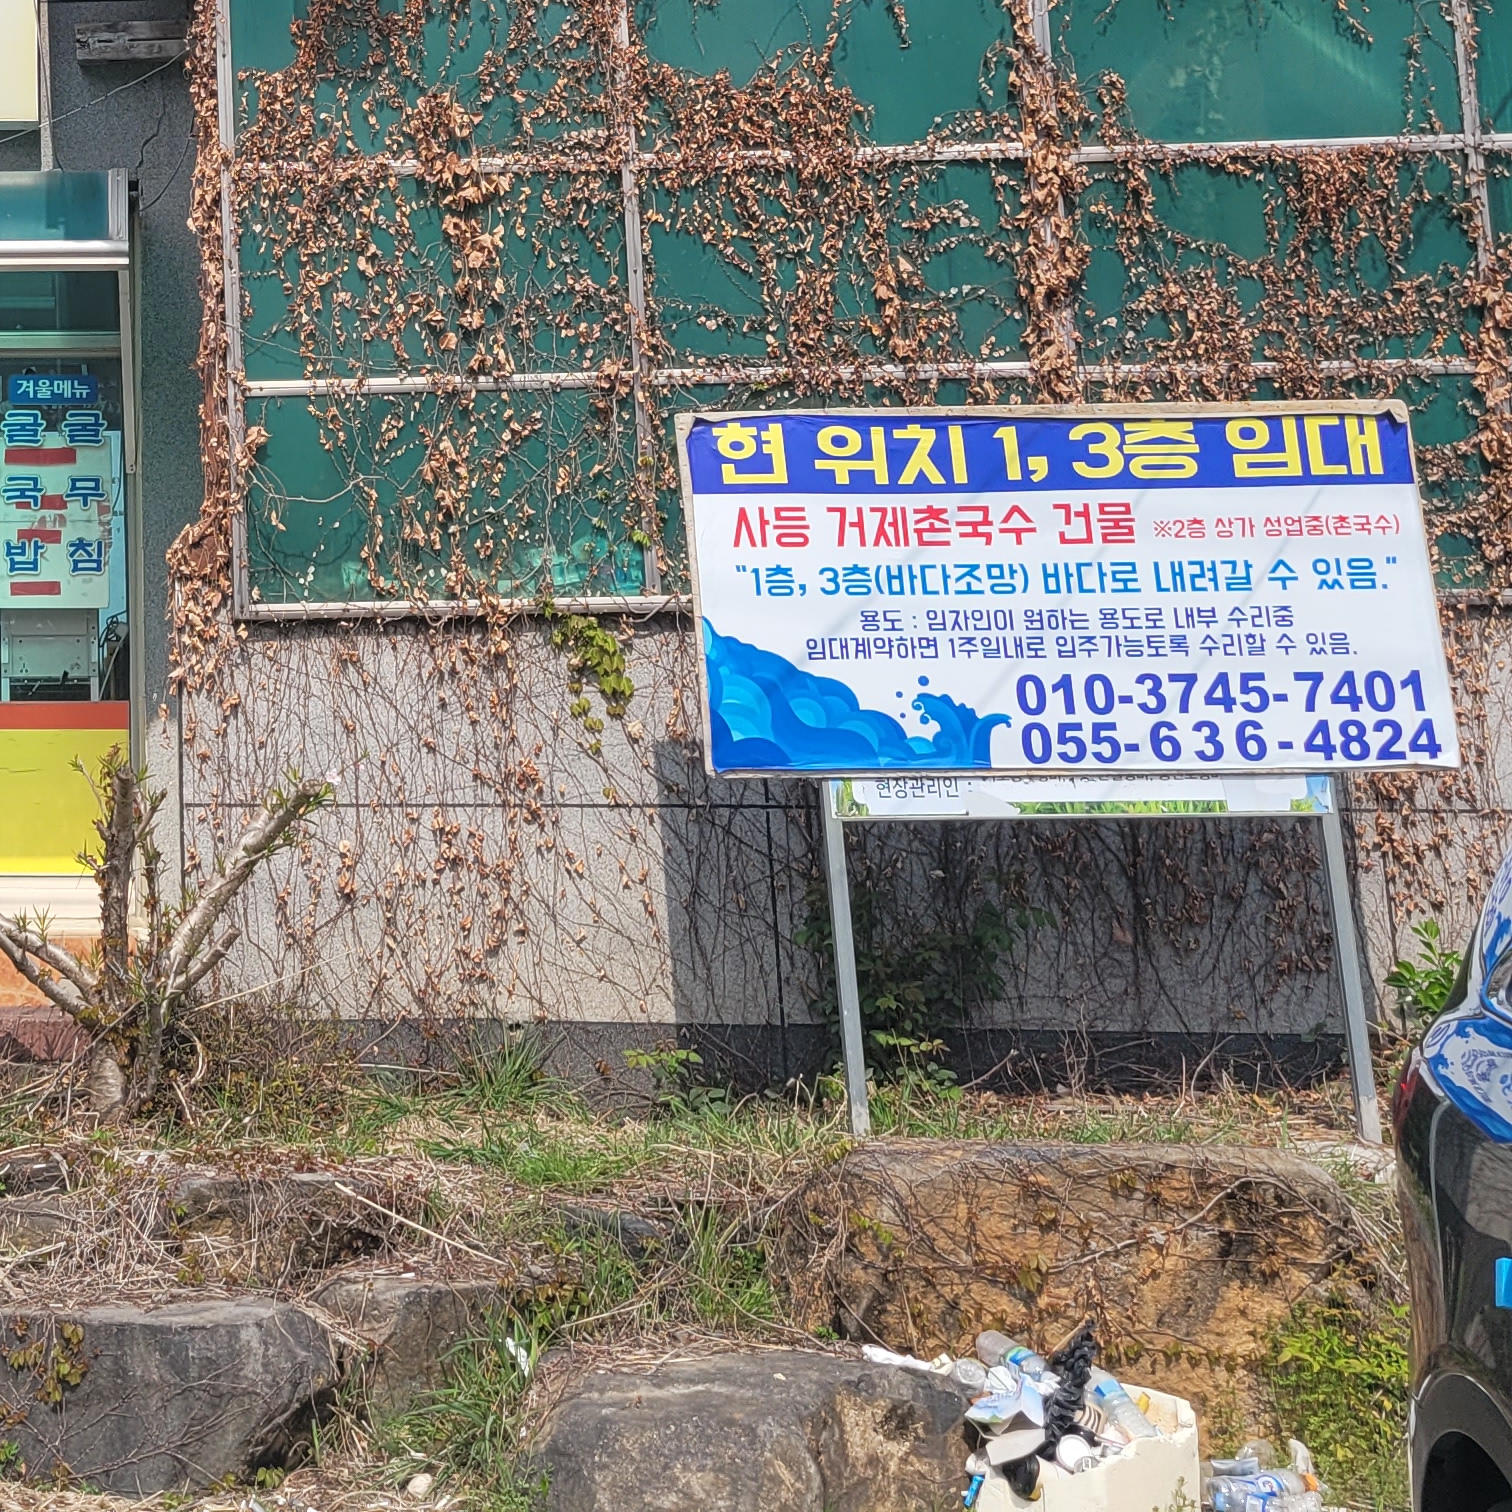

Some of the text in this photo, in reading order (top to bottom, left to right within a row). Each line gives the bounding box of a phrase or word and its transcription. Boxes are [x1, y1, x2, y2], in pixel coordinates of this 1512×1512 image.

[16, 379, 91, 399] 겨울메뉴
[711, 416, 1384, 485] 현 위치 1, 3층 임대
[1, 409, 47, 574] 굴국밥
[62, 409, 107, 574] 굴무침
[733, 506, 810, 548] 사등
[826, 504, 1037, 548] 거제촌국수
[1052, 502, 1136, 545] 건물
[1214, 516, 1255, 538] 상가
[1263, 514, 1400, 538] 성업중(촌국수)
[735, 556, 1398, 597] "1층, 3층(바다조망) 바다로 내려갈 수 있음."
[859, 609, 904, 632] 용도
[1023, 608, 1090, 631] 원하는
[1098, 606, 1167, 630] 용도로
[1174, 606, 1219, 630] 내부
[1227, 605, 1294, 629] 수리중
[805, 631, 1358, 661] 임대계약하면 1주일내로 입주가능토록 수리할 수 있음.
[1016, 669, 1427, 716] 010-3745-7401
[1021, 718, 1442, 764] 055-636-4824
